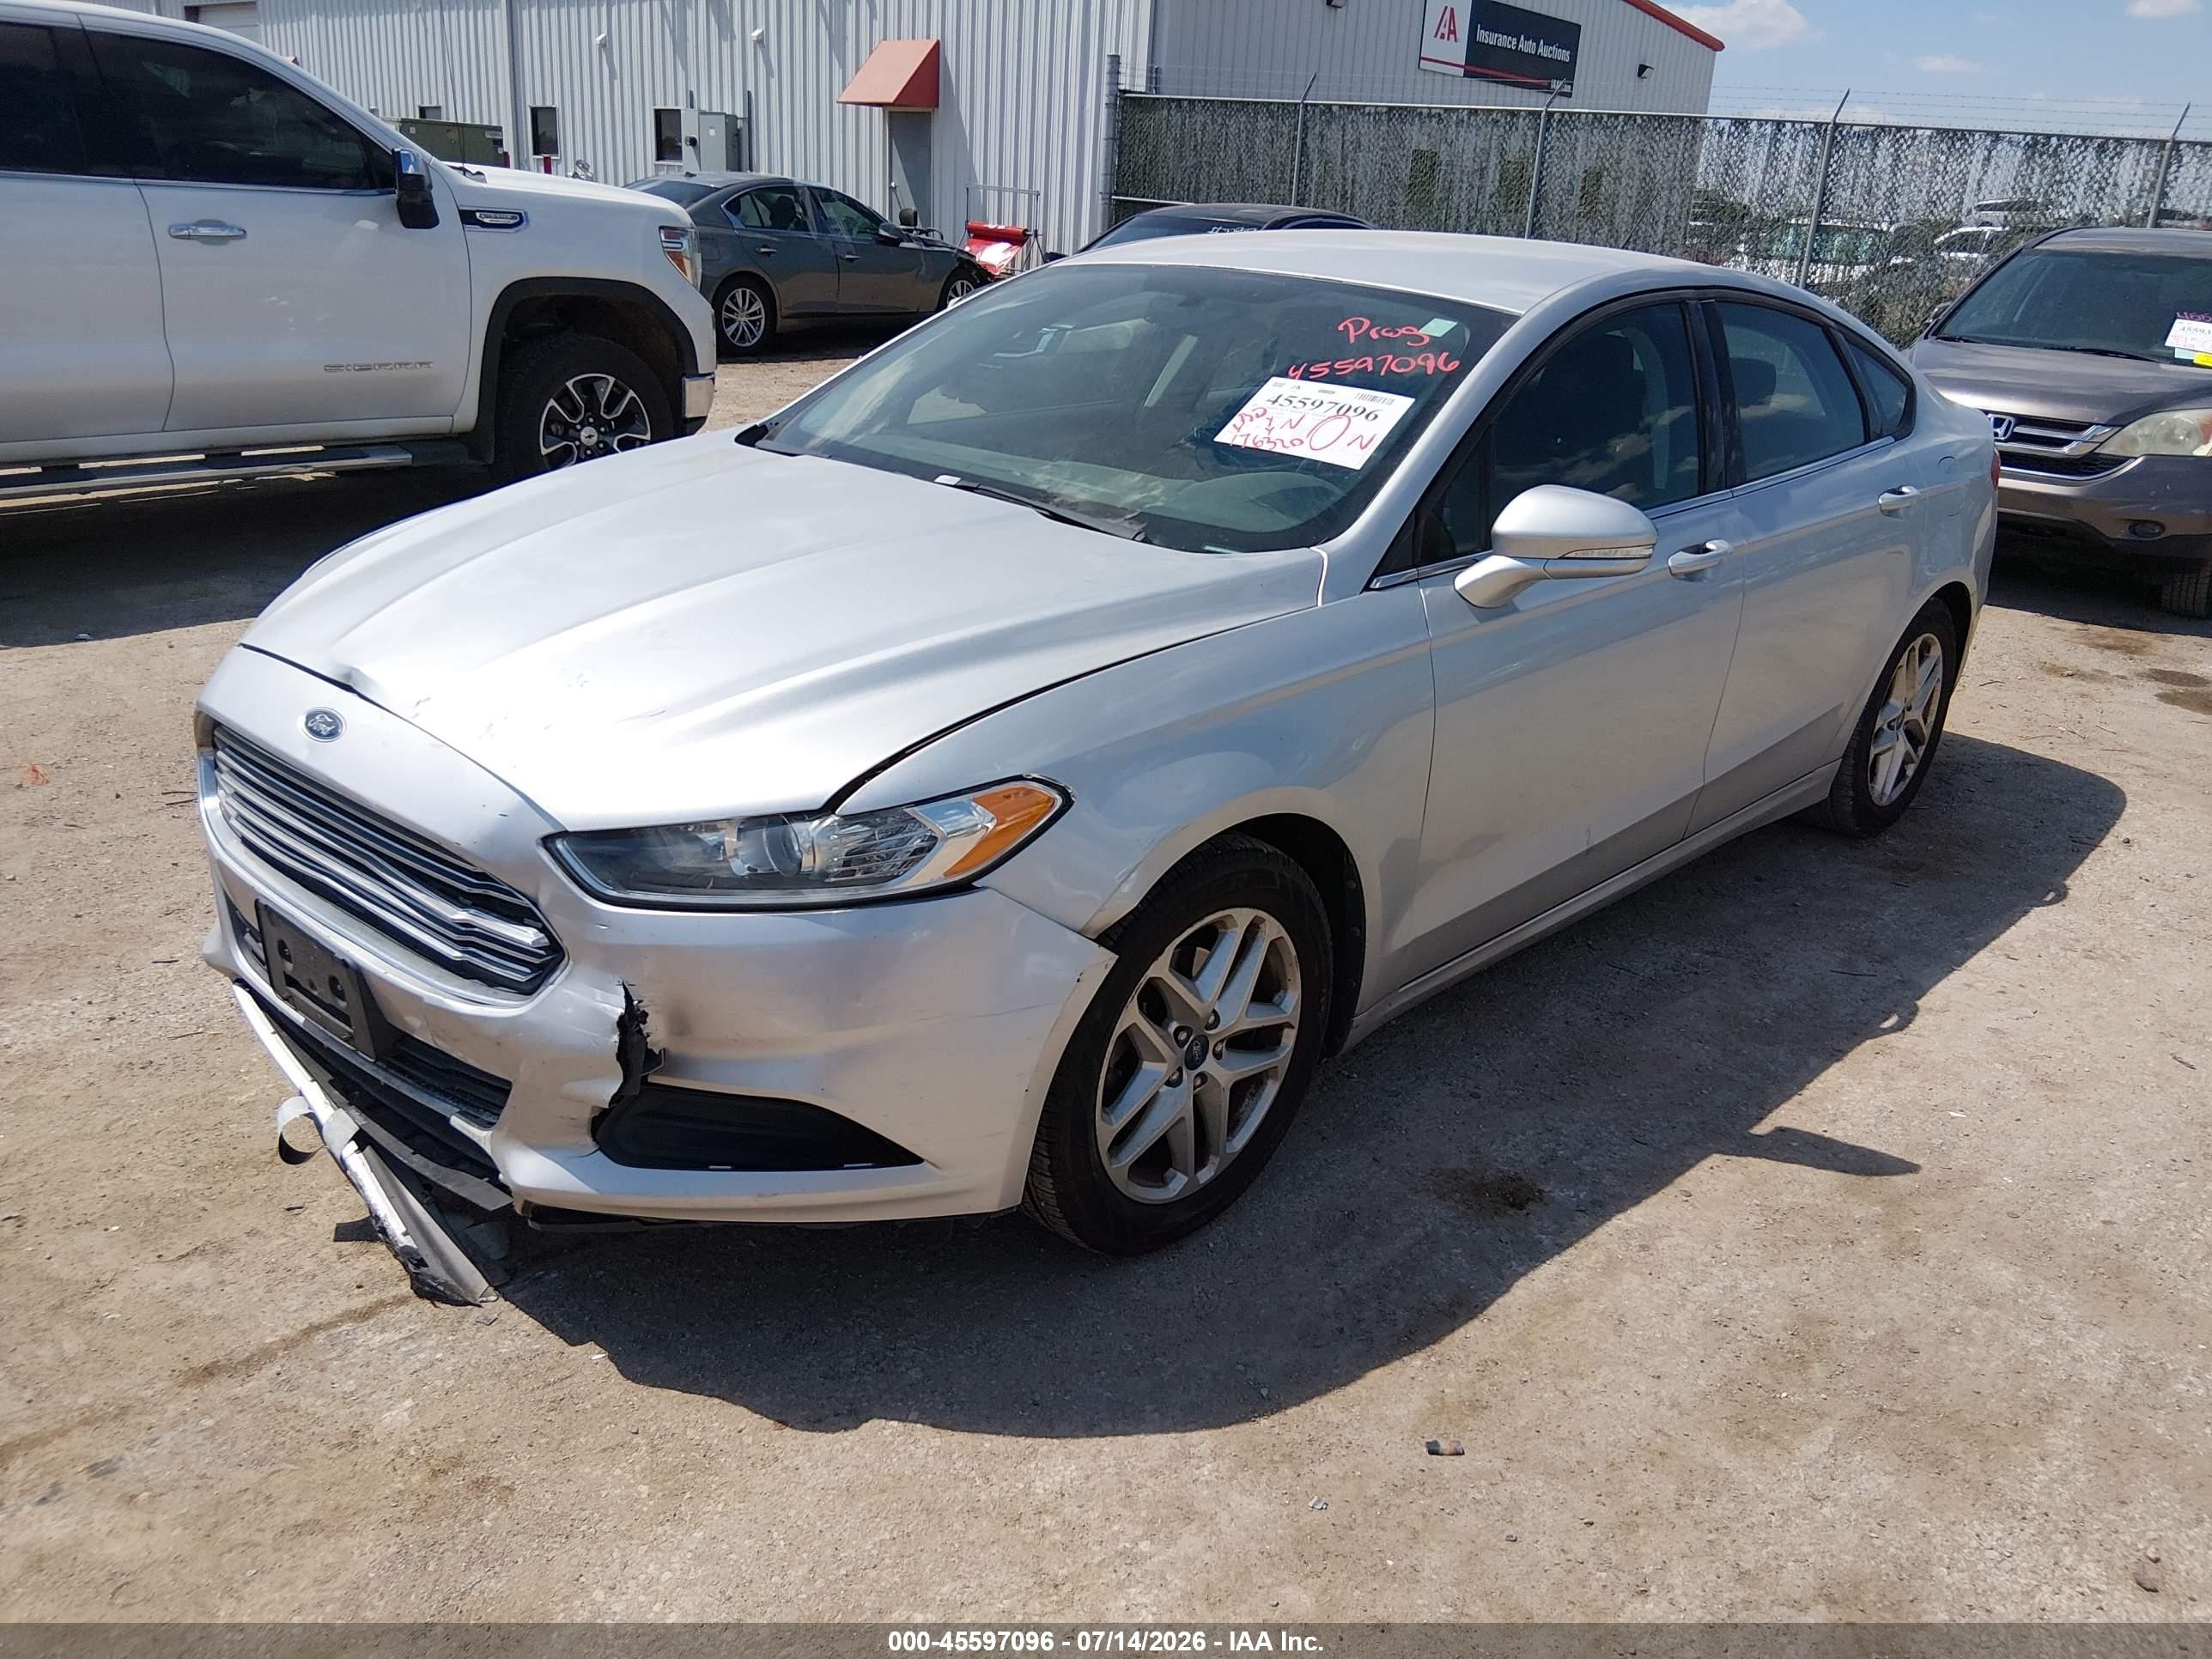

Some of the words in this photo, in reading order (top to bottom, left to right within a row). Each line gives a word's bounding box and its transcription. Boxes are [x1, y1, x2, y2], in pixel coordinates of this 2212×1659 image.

[1476, 23, 1517, 50] Insurance
[1518, 34, 1536, 54] Auto
[1537, 40, 1571, 63] Auctions
[1288, 350, 1460, 380] 45597096
[1266, 392, 1384, 422] 45597096
[308, 714, 336, 735] Ford
